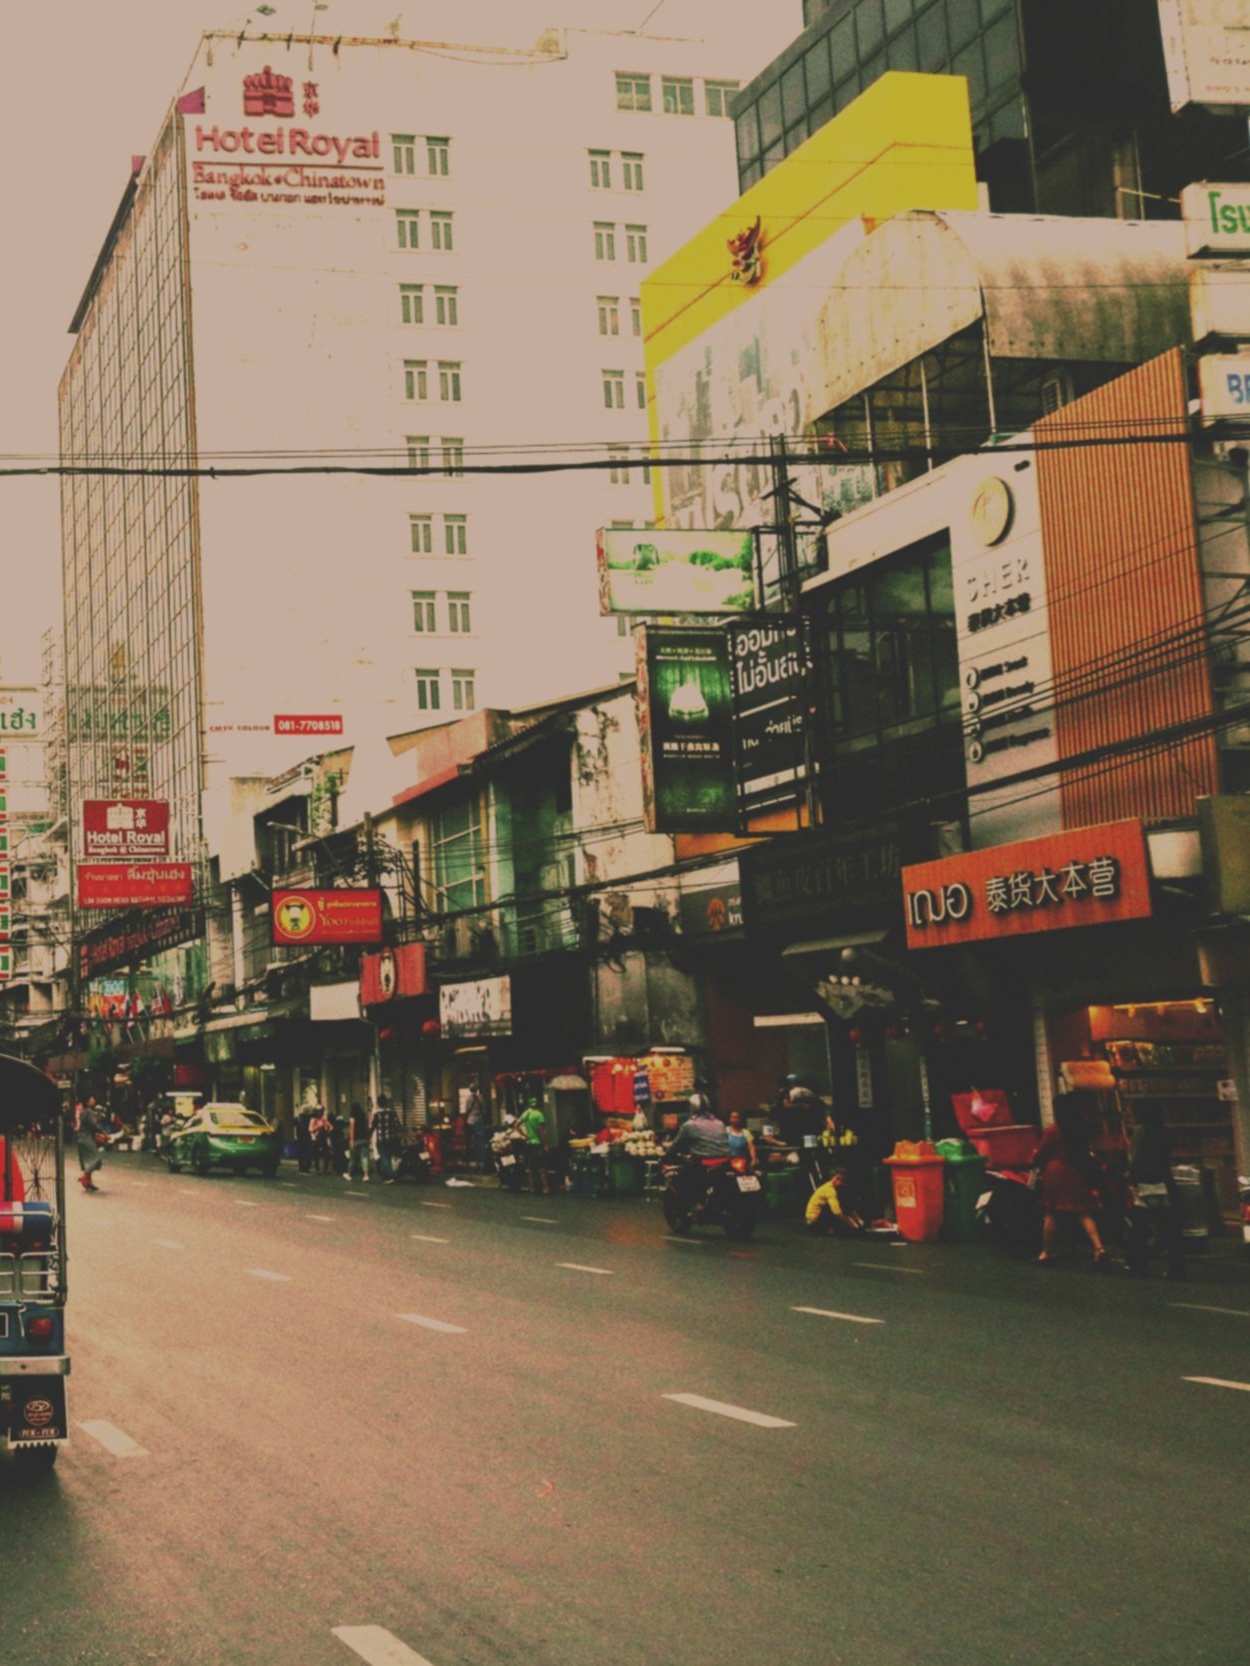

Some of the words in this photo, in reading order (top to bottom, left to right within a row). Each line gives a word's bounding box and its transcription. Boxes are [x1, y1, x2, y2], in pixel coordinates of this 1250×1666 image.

[195, 125, 284, 154] Hotel
[289, 128, 380, 163] Royal
[283, 166, 385, 190] Chinatown
[1208, 191, 1250, 233] โร
[87, 830, 123, 844] Hotel
[127, 830, 165, 845] Royal
[985, 857, 1115, 912] 泰货大本营
